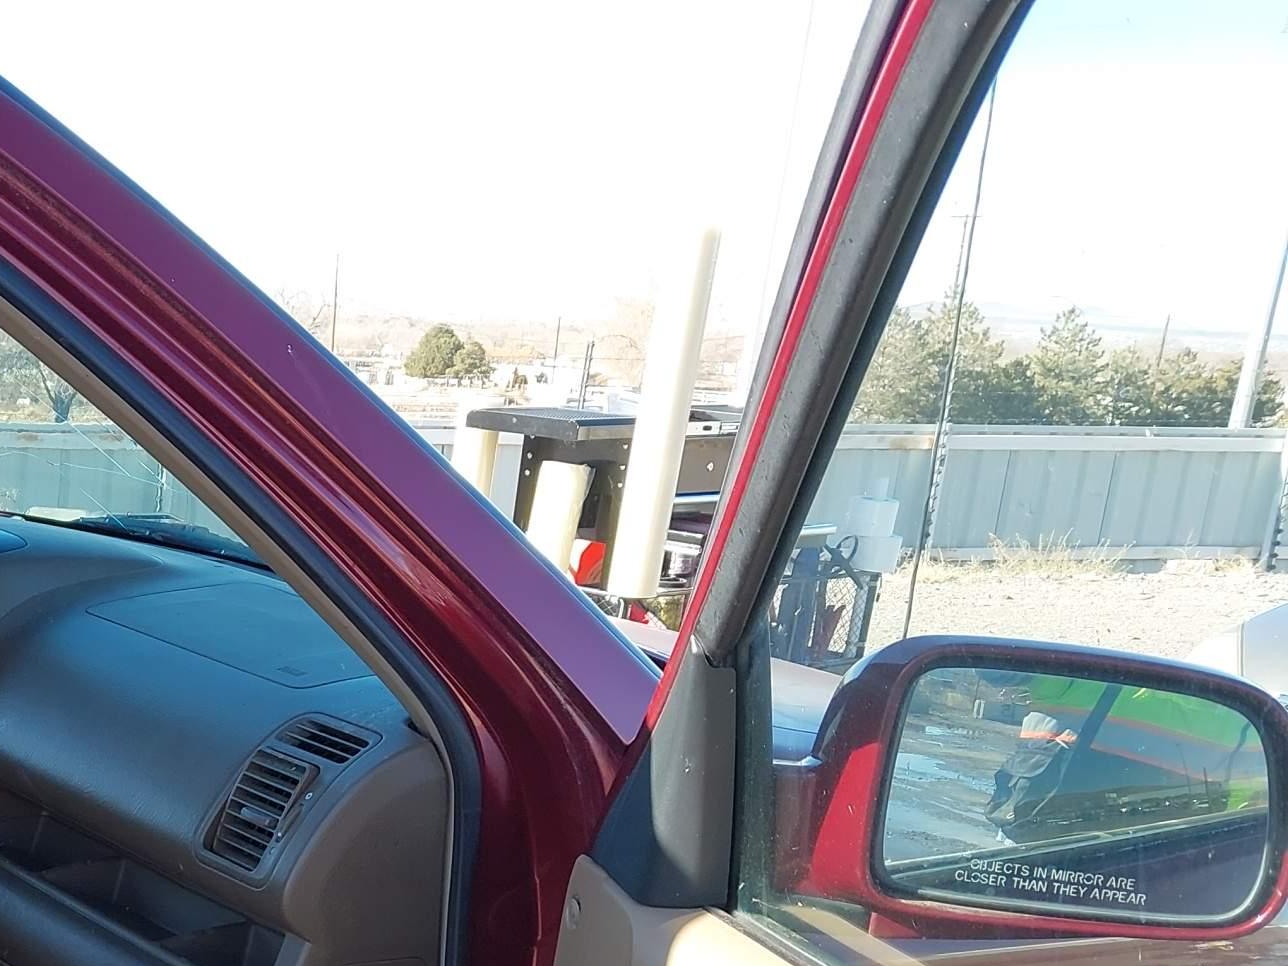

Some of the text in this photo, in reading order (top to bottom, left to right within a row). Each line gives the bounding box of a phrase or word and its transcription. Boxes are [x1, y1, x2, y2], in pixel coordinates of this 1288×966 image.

[955, 870, 1146, 905] CLOSER THAN THEY APPEAR
[970, 858, 1136, 890] OBJECTS IN MIRROR ARE
